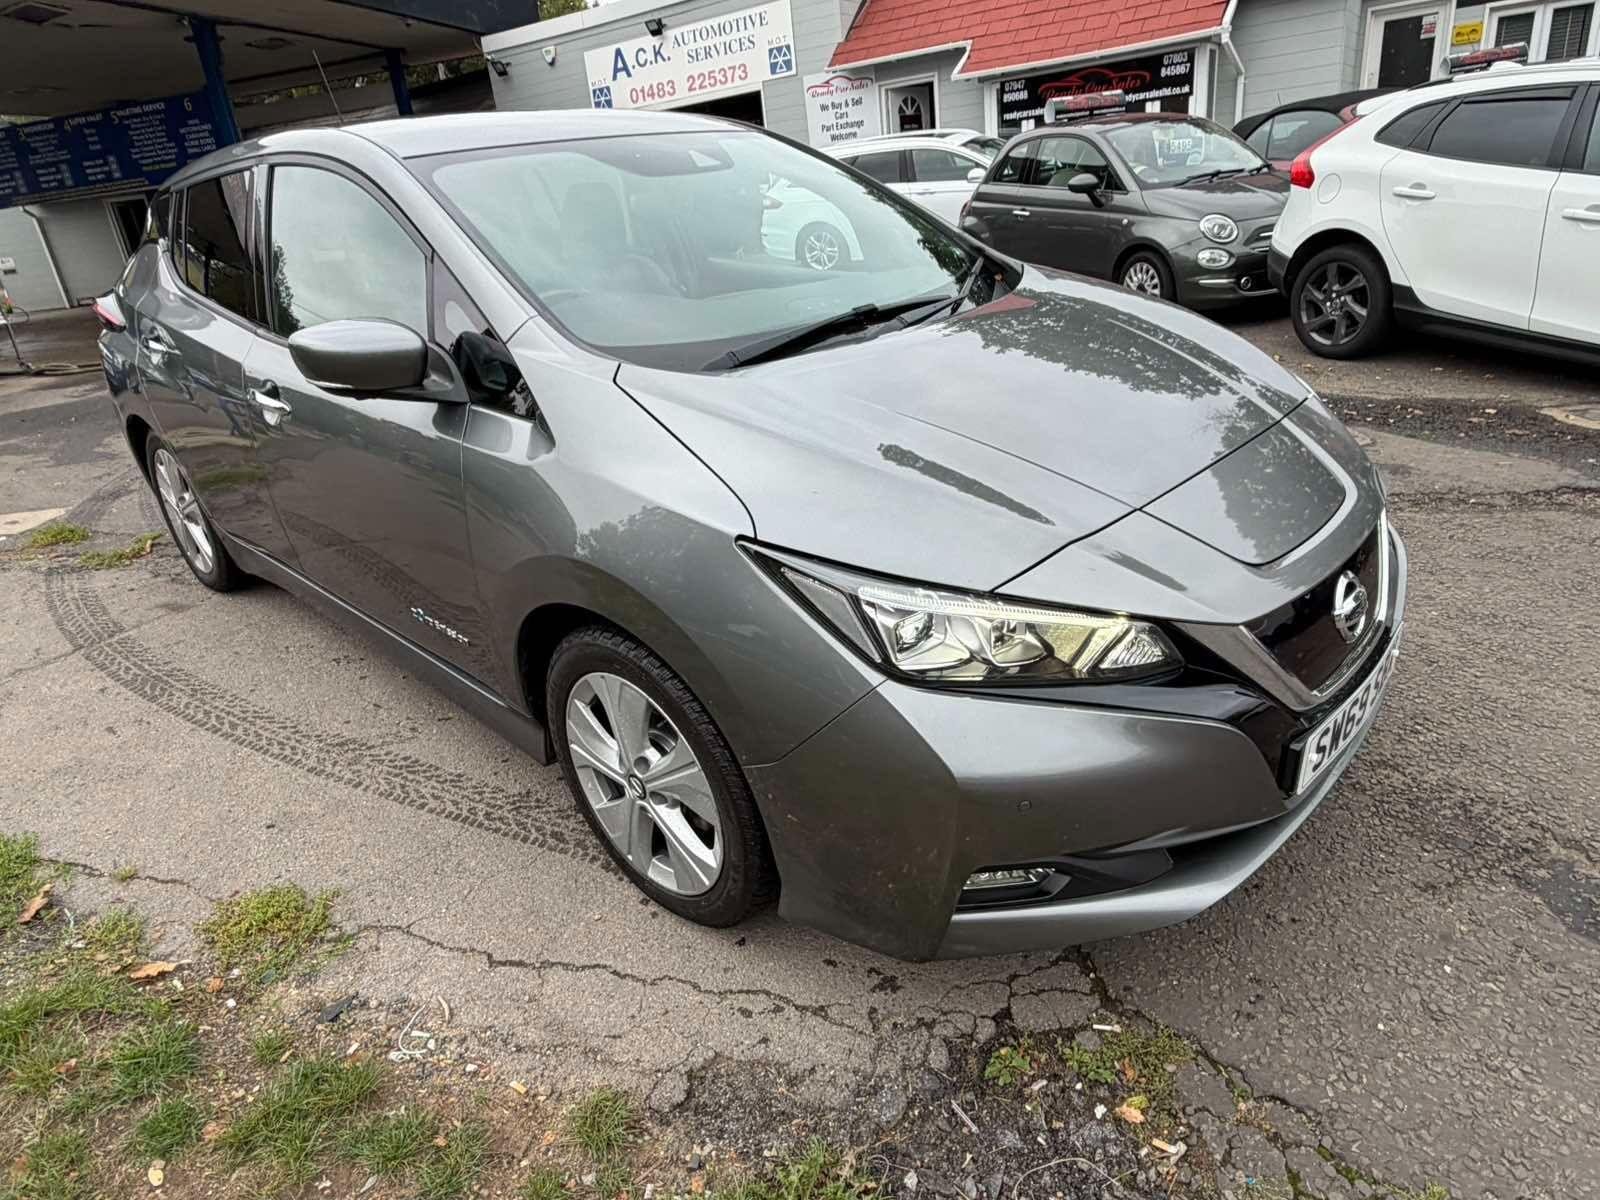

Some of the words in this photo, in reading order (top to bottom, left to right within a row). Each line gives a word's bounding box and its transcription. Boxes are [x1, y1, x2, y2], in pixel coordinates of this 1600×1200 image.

[672, 10, 768, 49] AUTOMOTIVE
[768, 35, 787, 45] MOT
[687, 34, 756, 64] SERVICES
[591, 78, 608, 86] MOT
[629, 79, 677, 104] 01483
[686, 63, 749, 92] 225373
[184, 98, 192, 111] 6
[820, 104, 829, 112] We
[831, 101, 842, 111] Buy
[844, 99, 849, 108] &
[851, 96, 863, 107] Sell
[834, 111, 848, 120] Cars
[821, 123, 834, 132] Part
[836, 119, 864, 131] Exchange
[830, 131, 857, 142] Welcome
[1312, 683, 1371, 773] SW69
